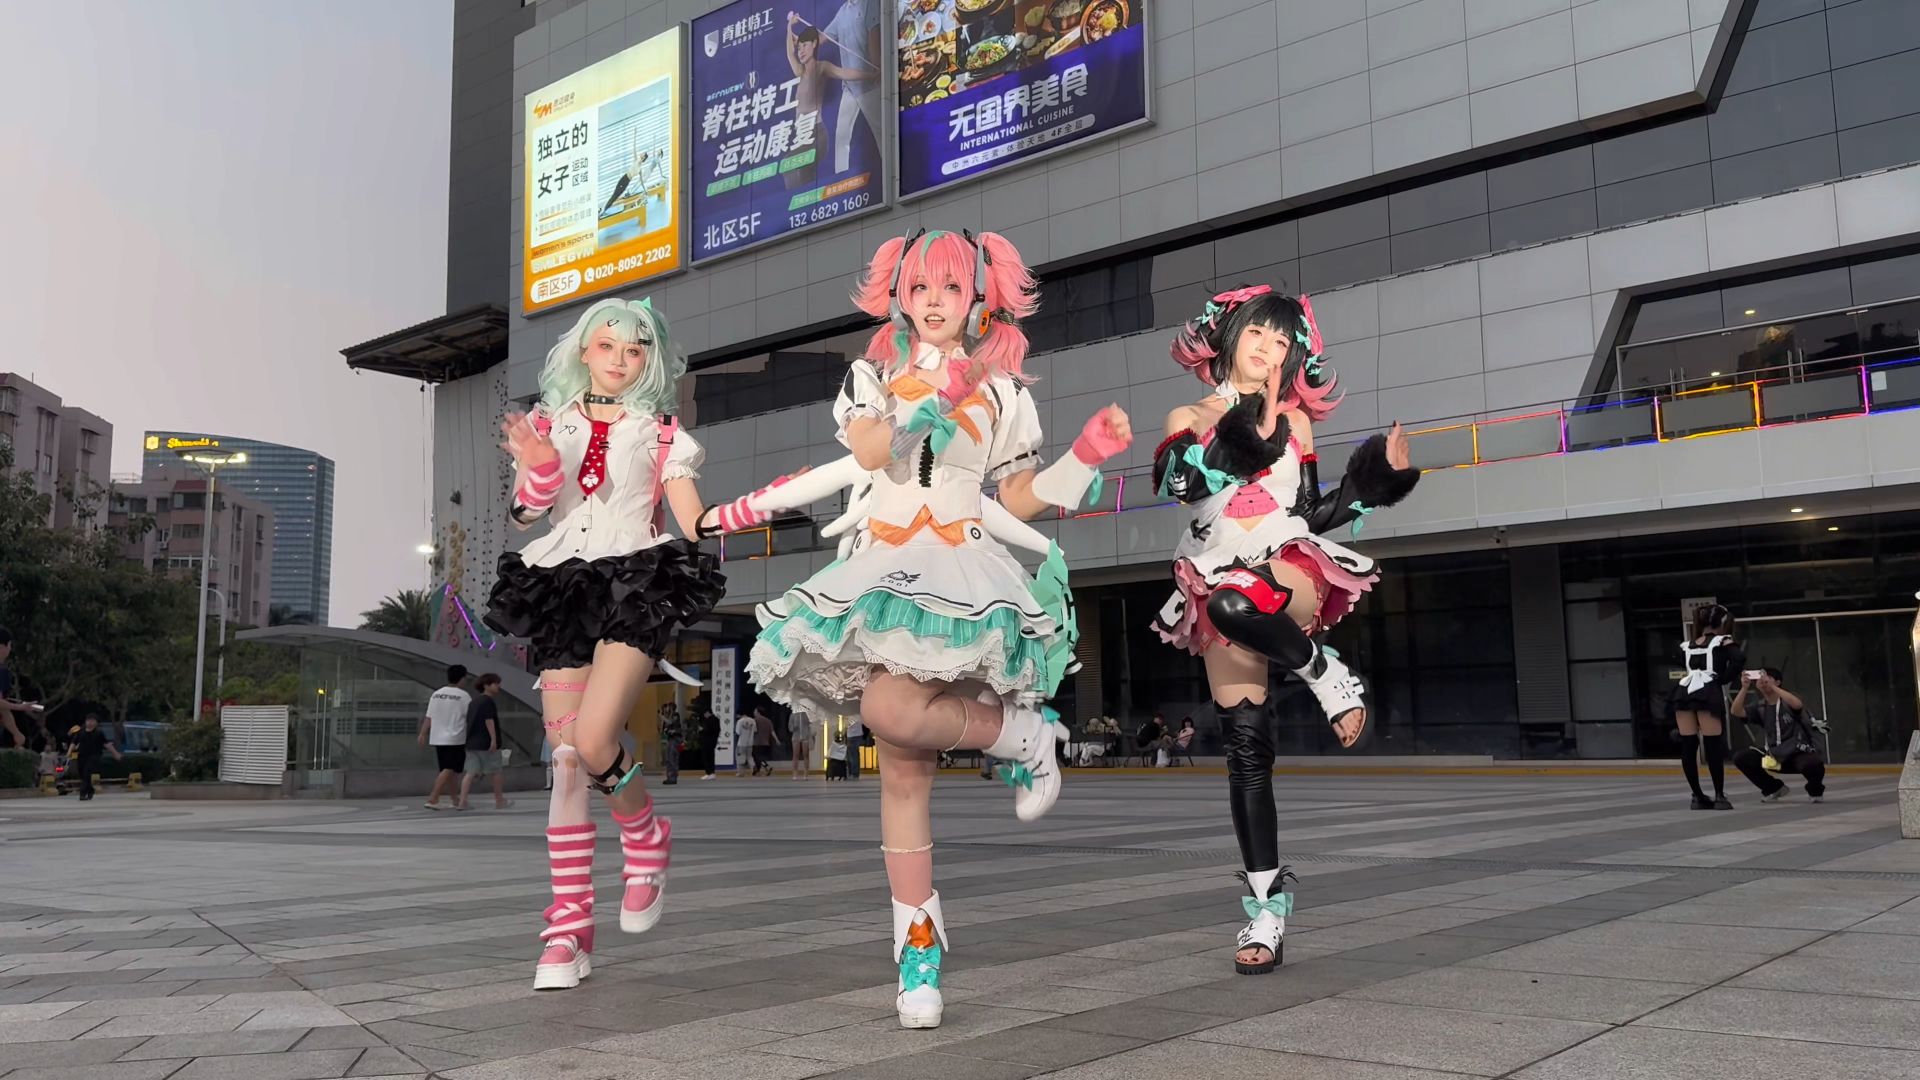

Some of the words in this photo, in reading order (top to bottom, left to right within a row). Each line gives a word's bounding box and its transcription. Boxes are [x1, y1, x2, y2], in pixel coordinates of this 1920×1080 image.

[702, 76, 802, 142] 脊柱特工
[949, 63, 1088, 141] 无国界美食
[538, 120, 588, 162] 独立的
[714, 110, 818, 178] 运动康复
[960, 121, 1034, 151] INTERNATIONAL
[1037, 105, 1075, 126] CUISINE
[537, 164, 570, 199] 女子
[571, 171, 589, 187] 区域
[788, 212, 807, 229] 132
[811, 202, 839, 222] 6829
[842, 192, 870, 212] 1609
[703, 212, 762, 250] 北区5F
[595, 254, 644, 279] 020-8092
[645, 244, 671, 264] 2202
[537, 274, 574, 299] 南区5F
